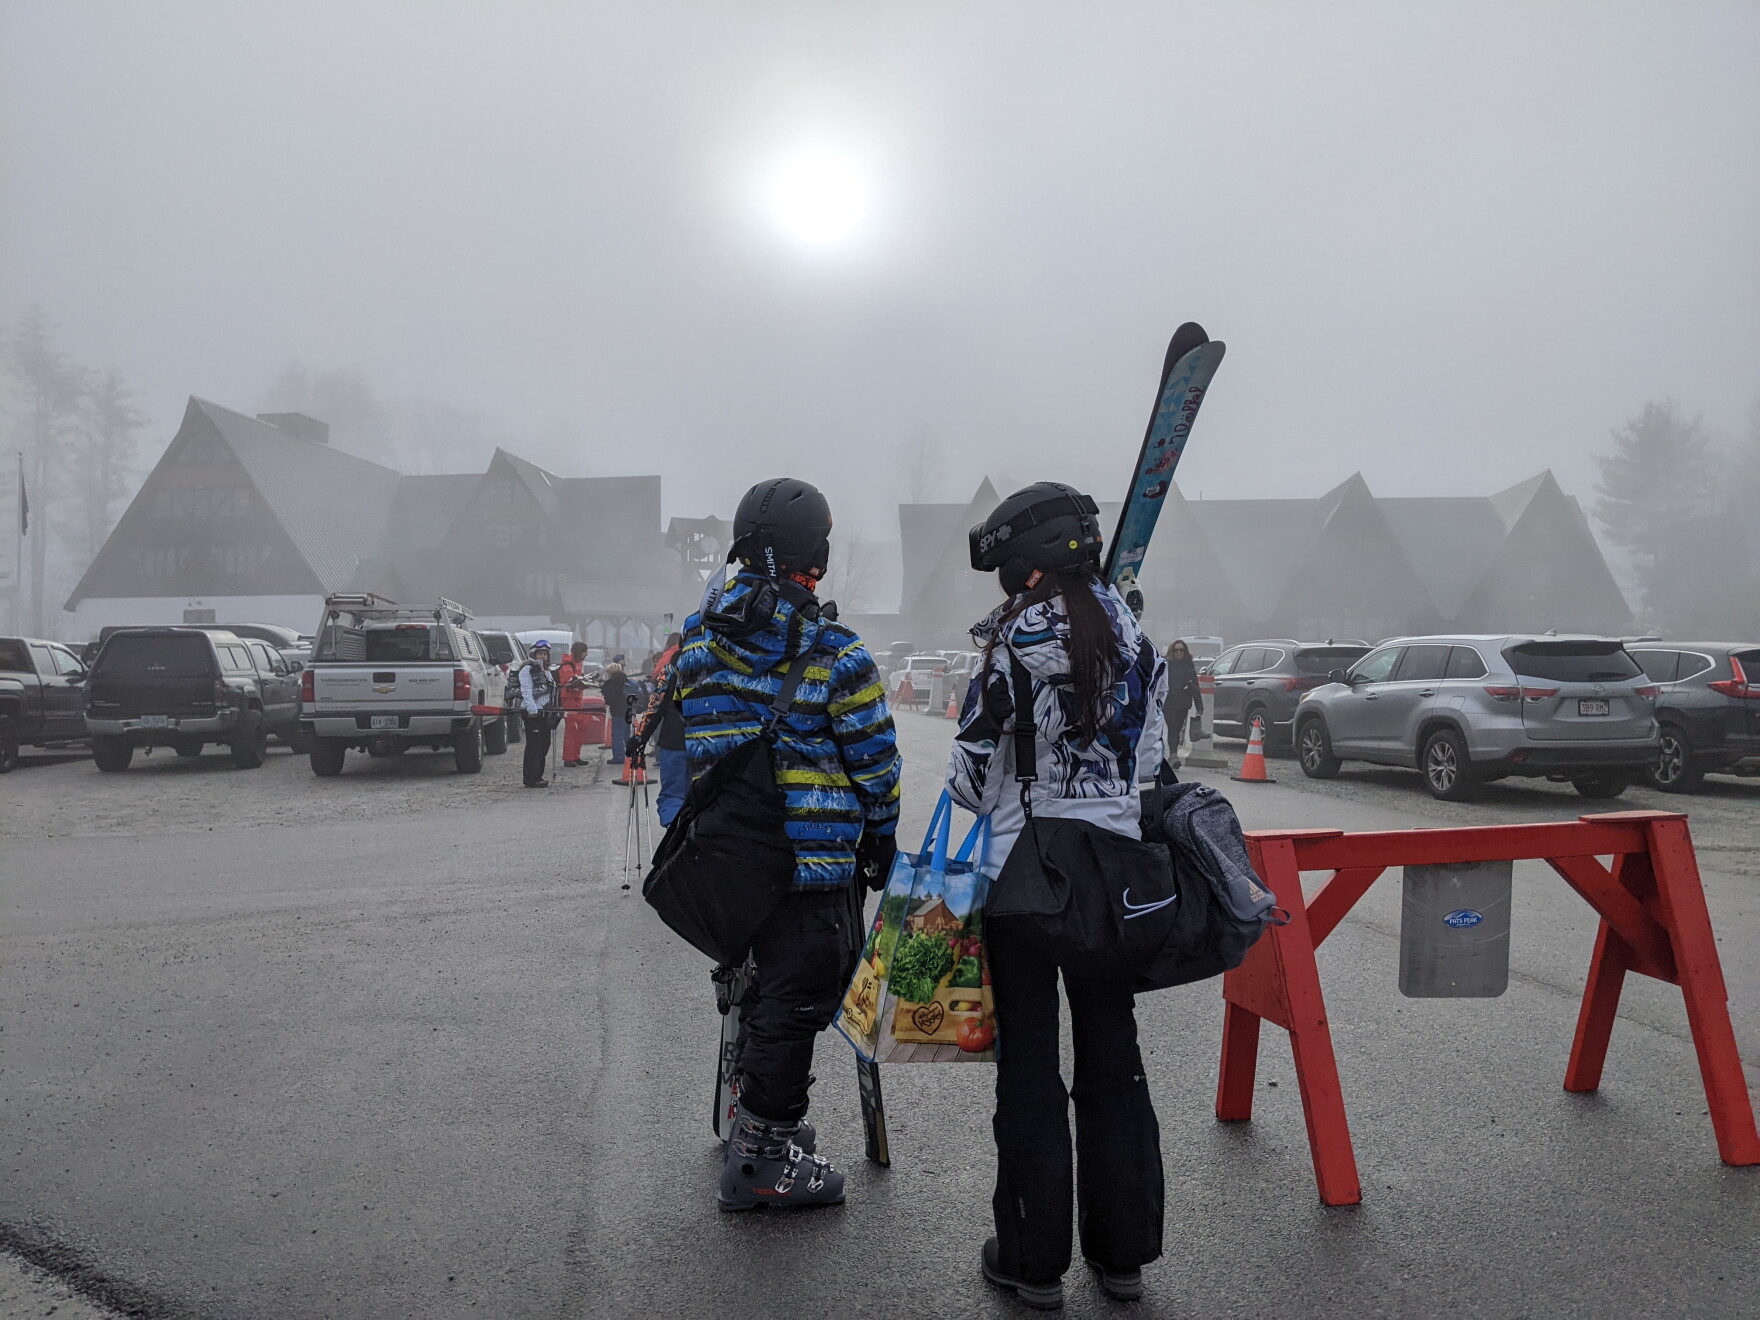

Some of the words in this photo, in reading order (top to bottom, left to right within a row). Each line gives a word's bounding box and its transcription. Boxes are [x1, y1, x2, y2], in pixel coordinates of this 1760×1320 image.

[764, 546, 777, 577] SMITH
[706, 587, 719, 612] MITH
[1580, 703, 1594, 713] 389
[1449, 917, 1463, 925] PATS
[1464, 916, 1478, 924] PEAK
